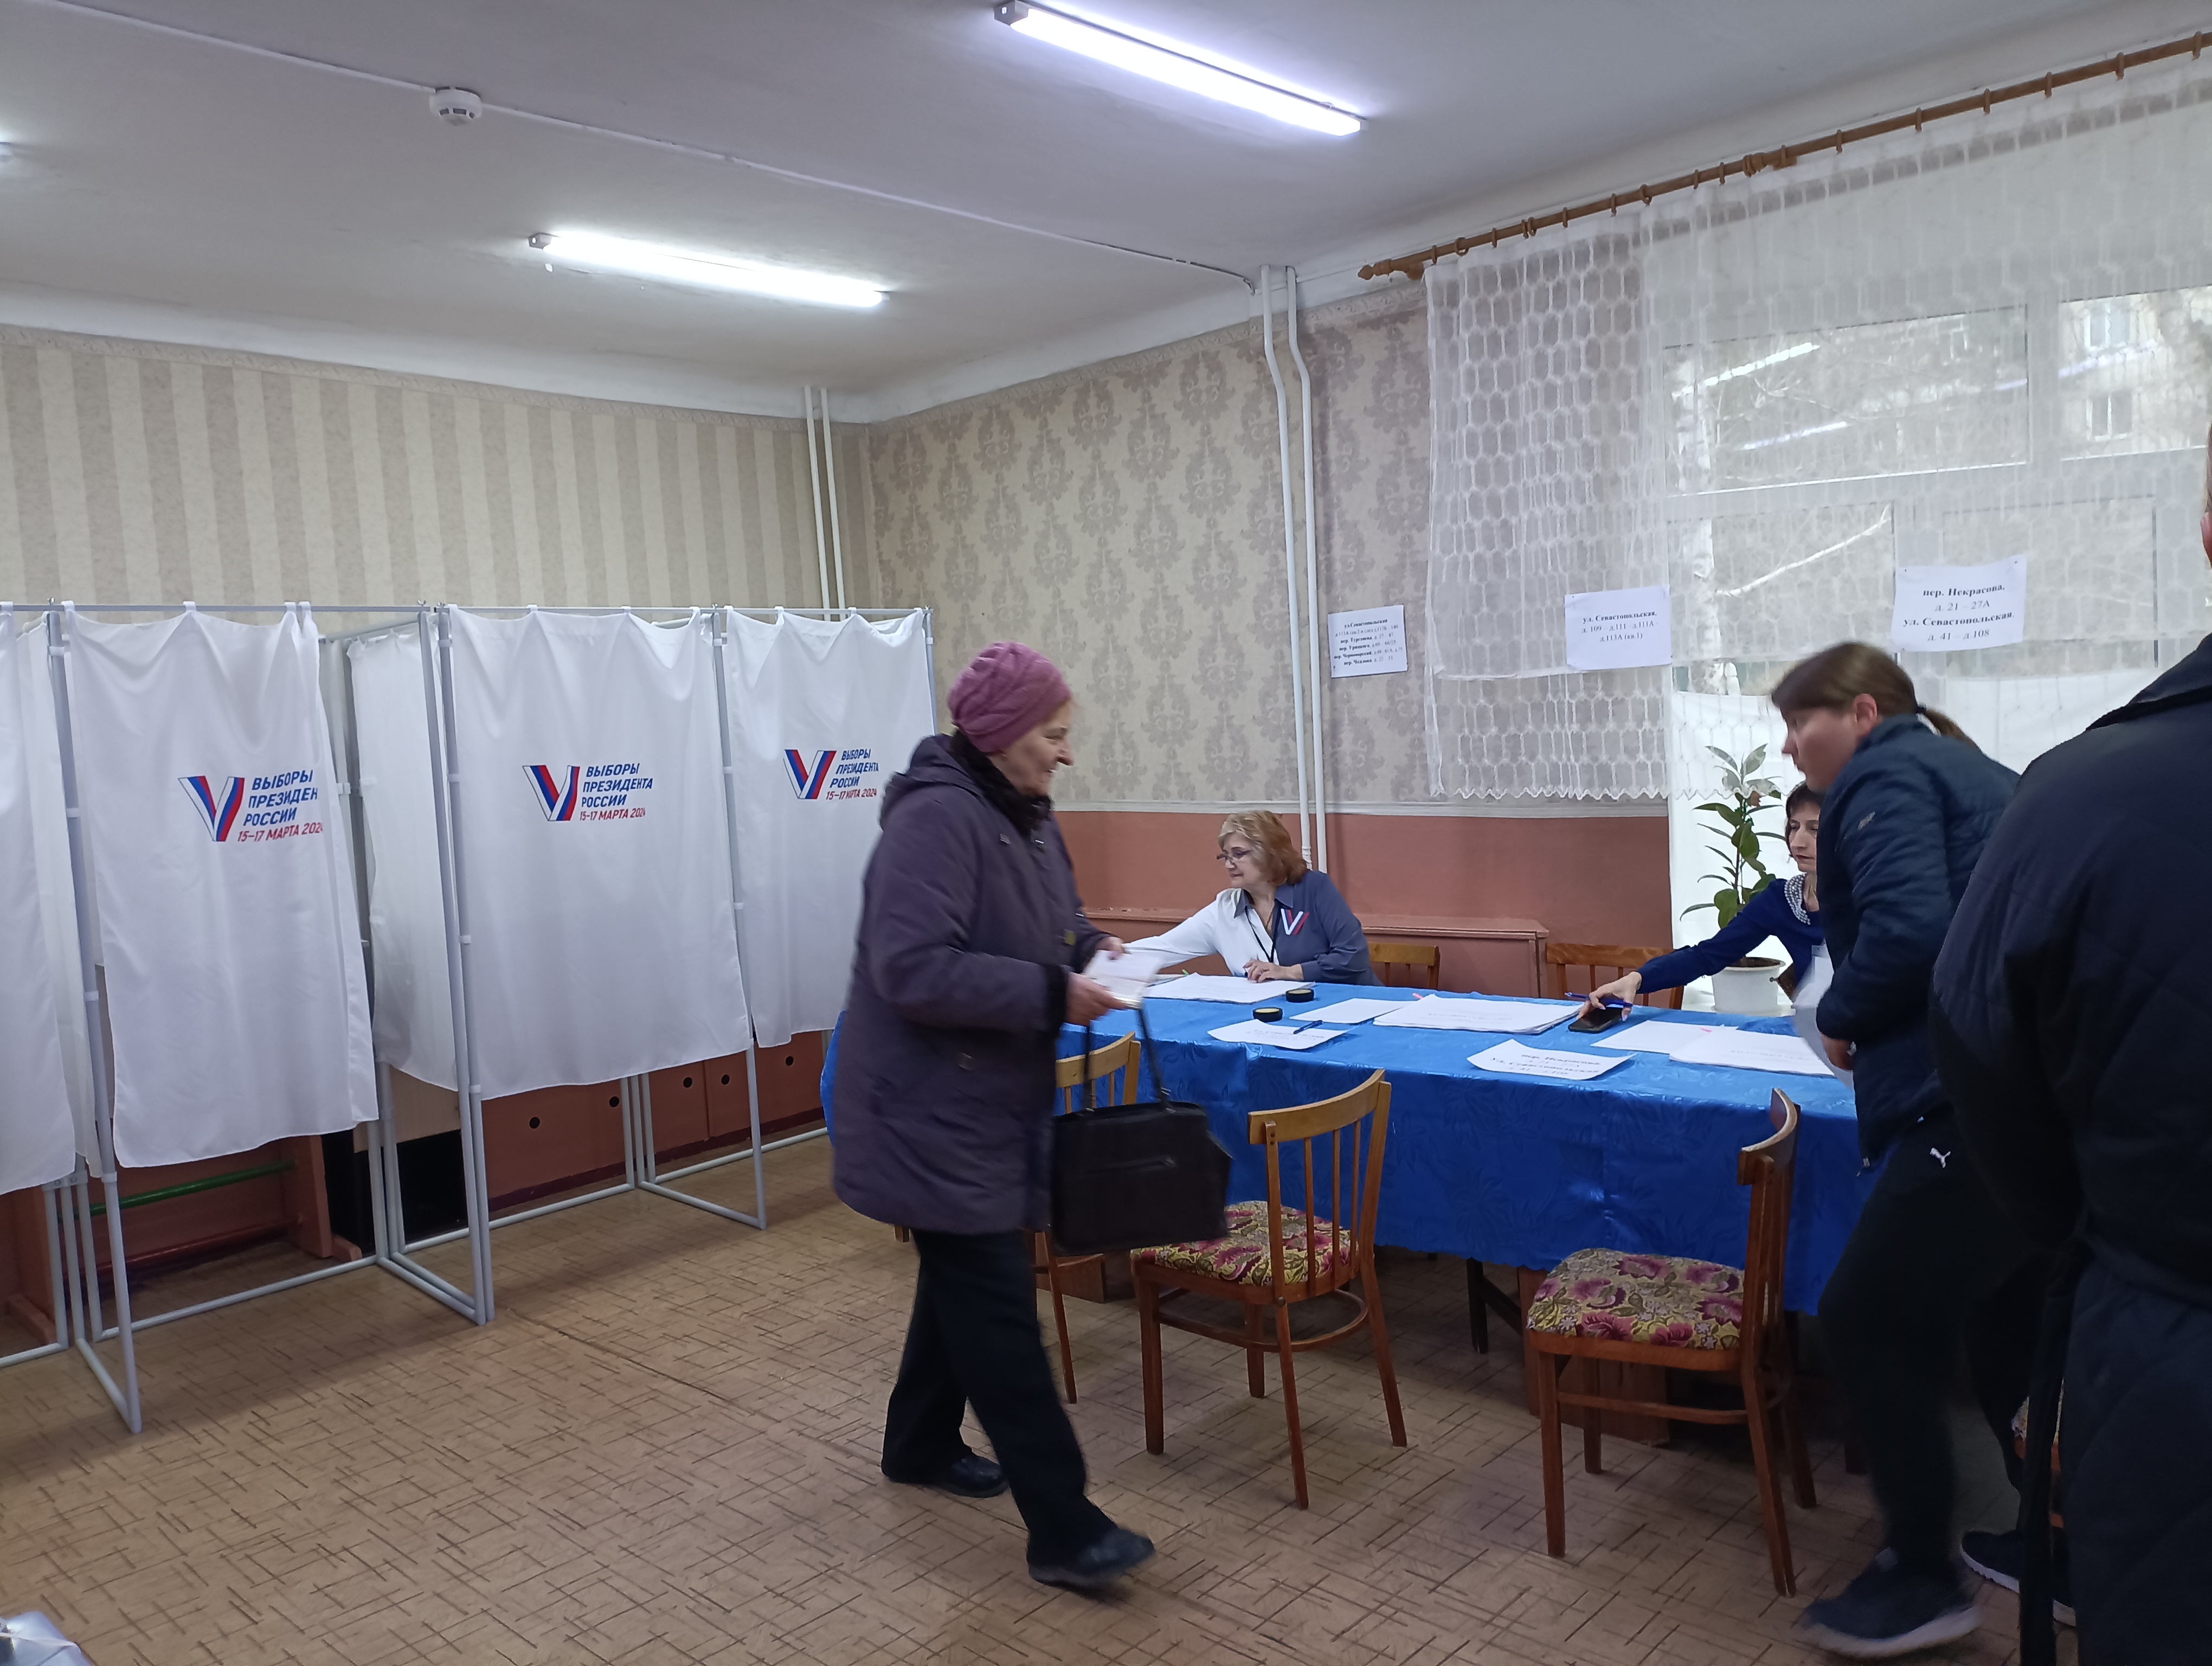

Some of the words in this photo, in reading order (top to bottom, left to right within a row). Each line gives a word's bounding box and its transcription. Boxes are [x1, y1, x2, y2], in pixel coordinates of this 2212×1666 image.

[1923, 589, 1944, 598] пер.
[1903, 619, 1919, 627] ул.
[841, 749, 871, 760] ВЫБОРЫ
[586, 763, 640, 777] ВЫБОРЫ
[835, 762, 879, 774] ПРЕЗИДЕНТА
[252, 770, 313, 790] ВЫБОРЫ
[583, 778, 653, 793] ПРЕЗИДЕНТА
[829, 776, 860, 788] РОССИИ
[248, 787, 318, 808] ПРЕЗИДЕН
[582, 794, 627, 808] РОССИИ
[243, 807, 297, 826] РОССИИ
[599, 809, 628, 821] МАРТА
[266, 824, 299, 841] МАРТА
